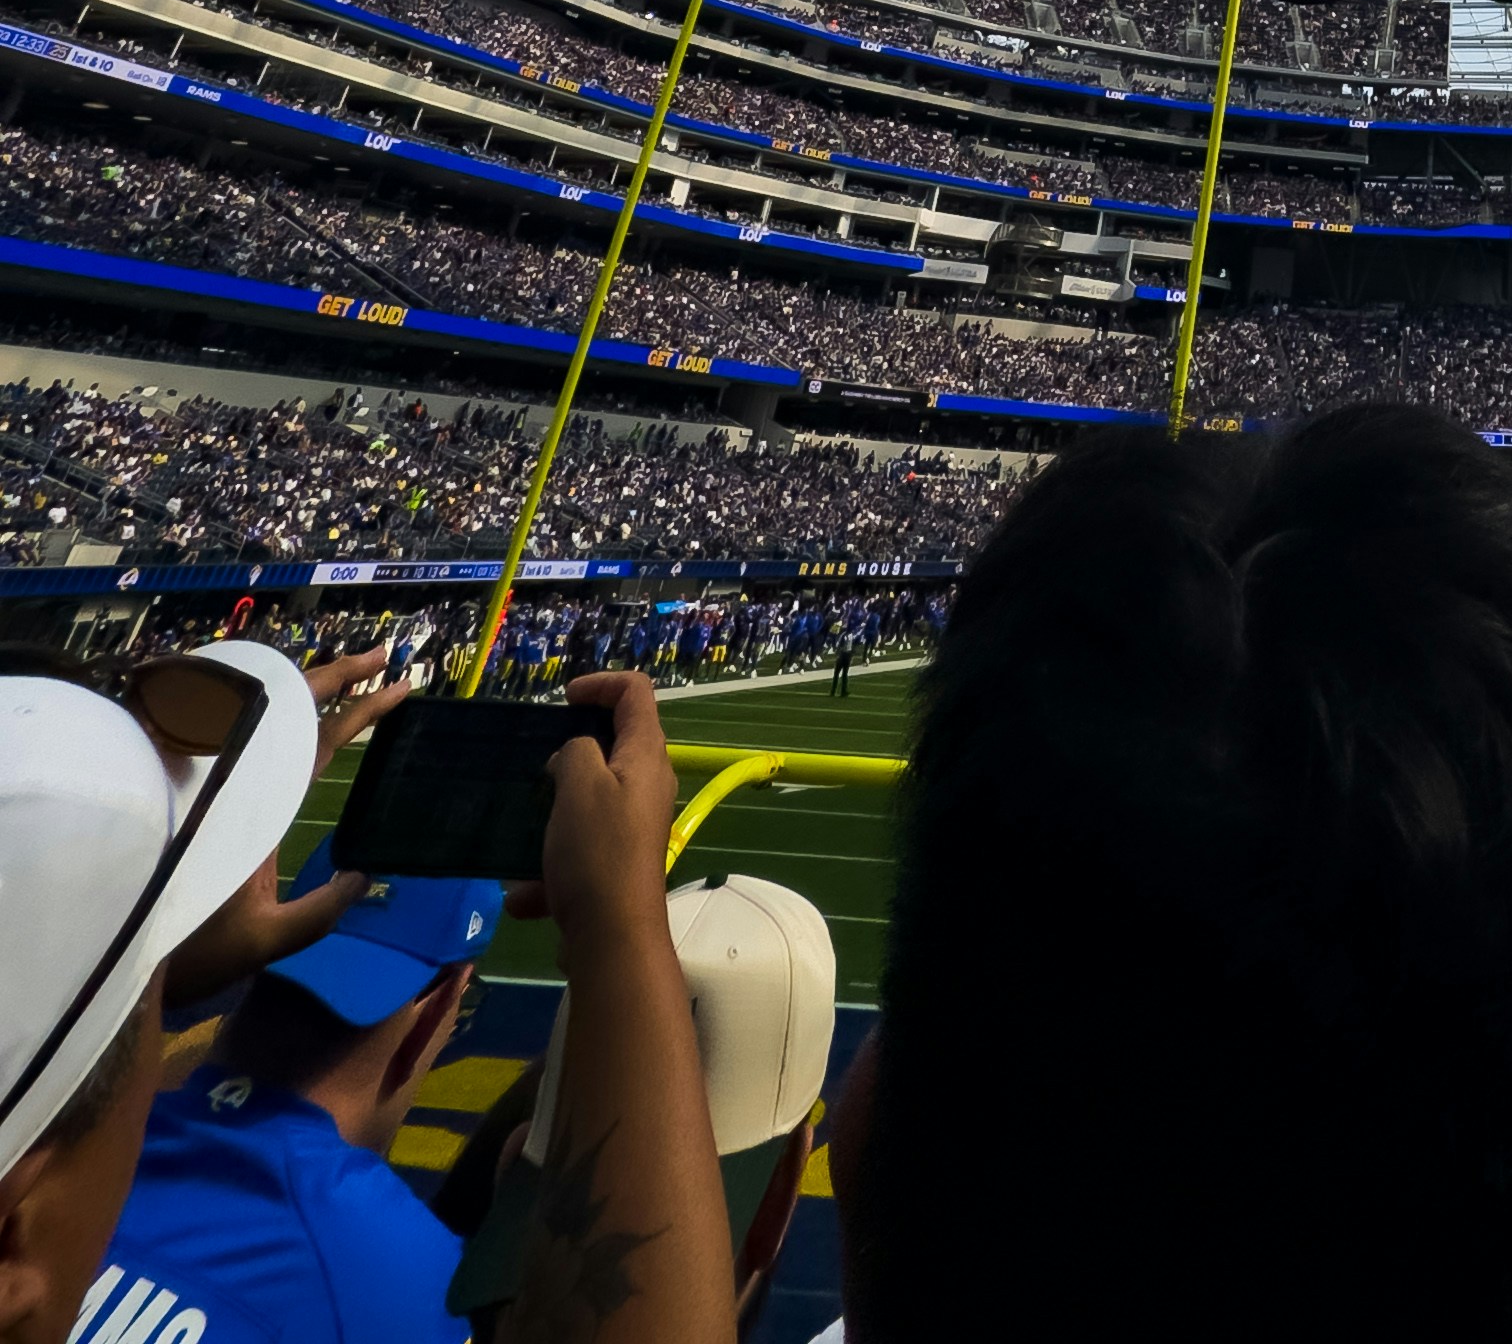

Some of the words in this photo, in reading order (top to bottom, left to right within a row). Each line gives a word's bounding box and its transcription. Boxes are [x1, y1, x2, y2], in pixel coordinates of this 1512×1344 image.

[186, 85, 222, 102] RAMS
[317, 294, 355, 317] GET
[357, 301, 408, 326] LOUD!
[647, 349, 674, 367] GET
[676, 354, 713, 373] LOUD!
[330, 566, 359, 581] 0:00
[798, 563, 848, 576] RAMS
[856, 563, 912, 576] HOUSE
